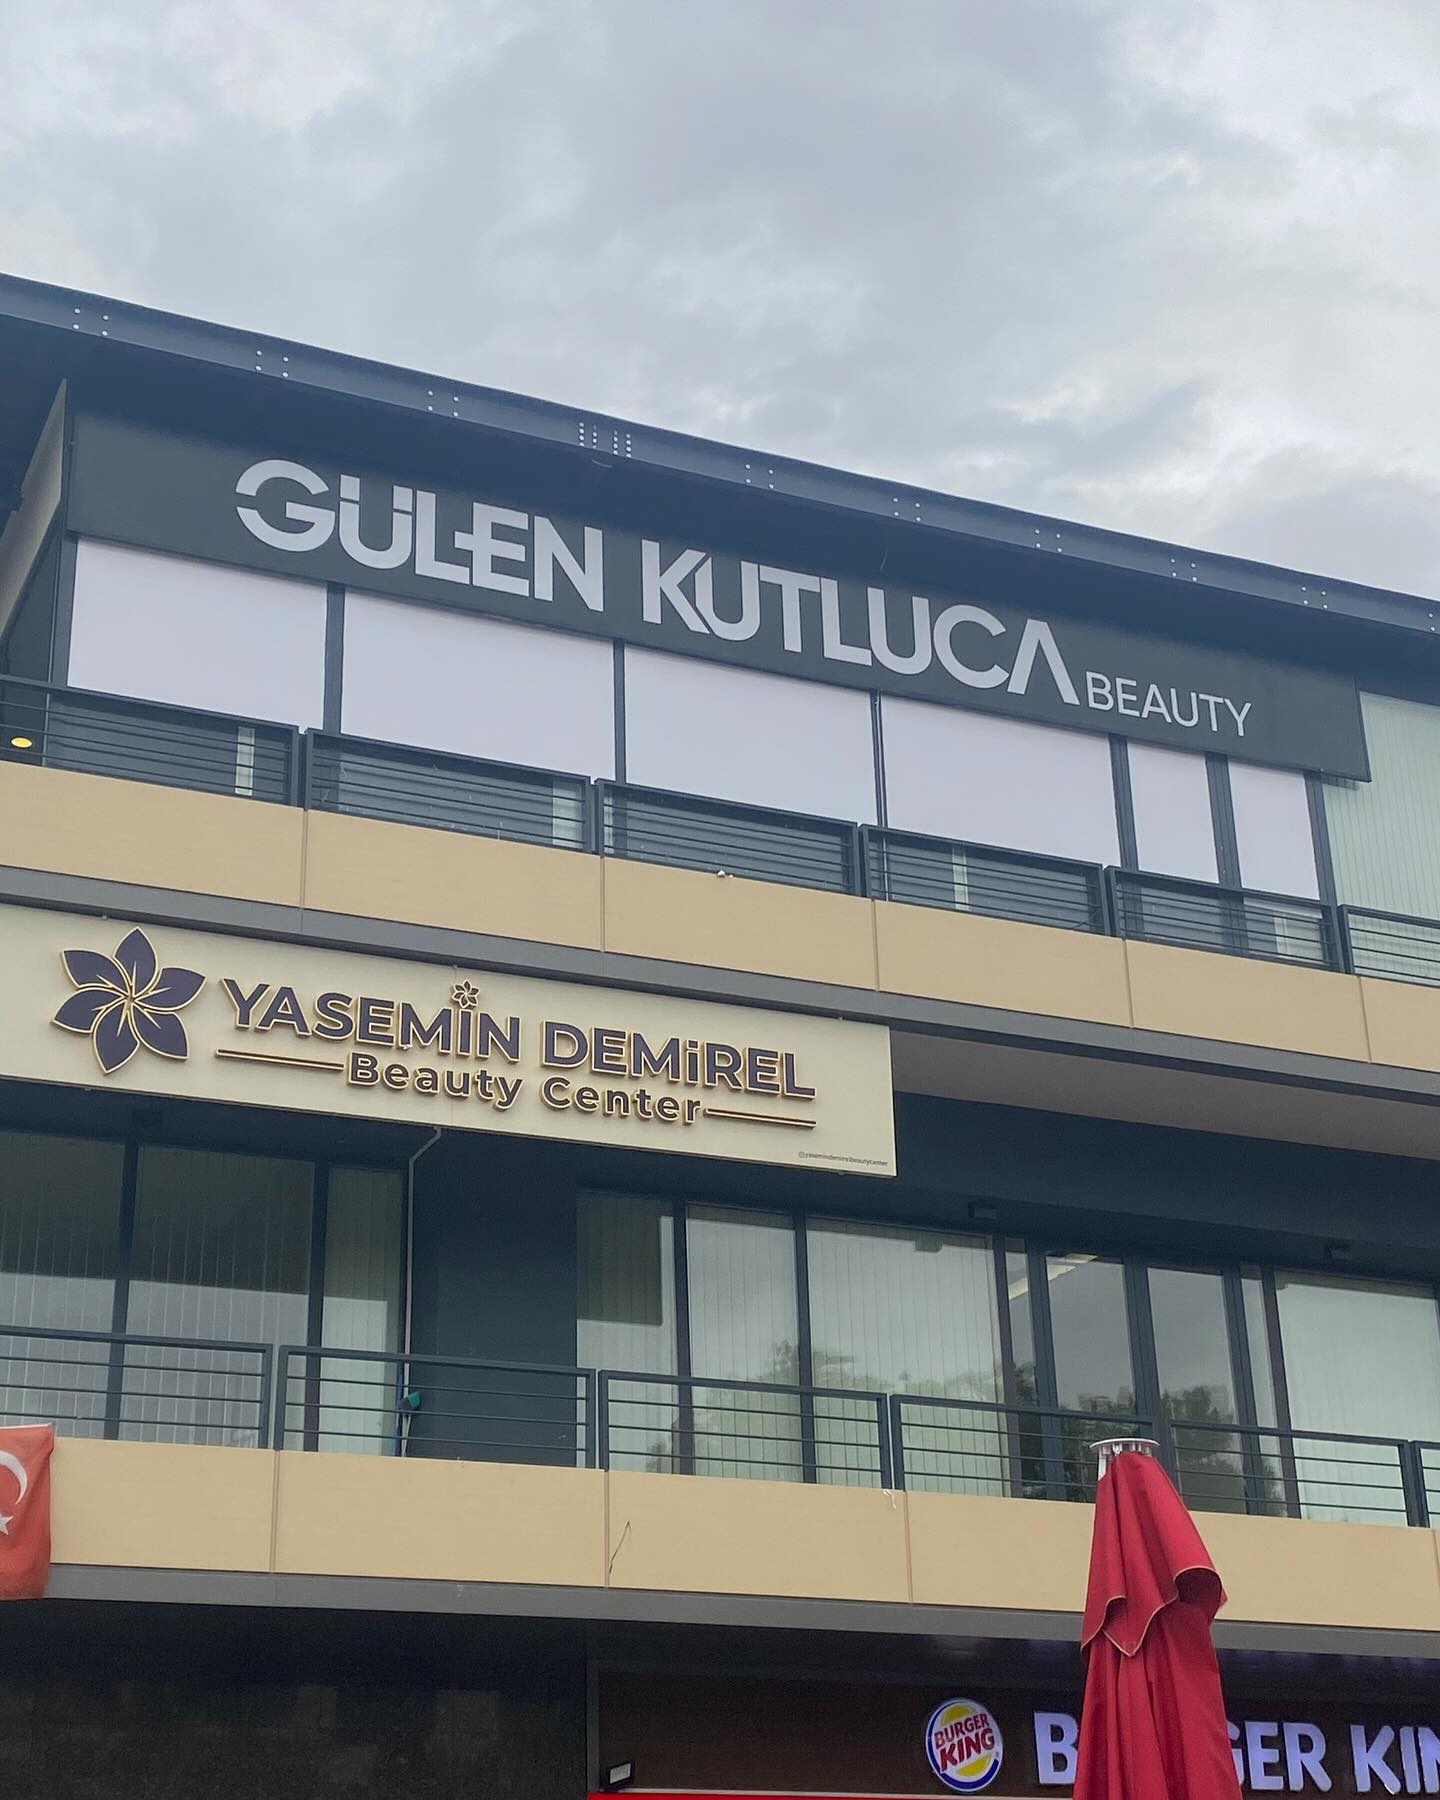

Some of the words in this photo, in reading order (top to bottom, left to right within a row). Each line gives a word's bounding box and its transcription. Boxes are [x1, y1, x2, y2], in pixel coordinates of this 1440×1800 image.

[641, 539, 1081, 705] KUTLUCA
[1085, 671, 1252, 737] BEAUTY
[347, 1052, 524, 1111] Beauty
[541, 1075, 702, 1124] Center
[934, 1712, 990, 1750] BURGER
[940, 1727, 996, 1772] KING
